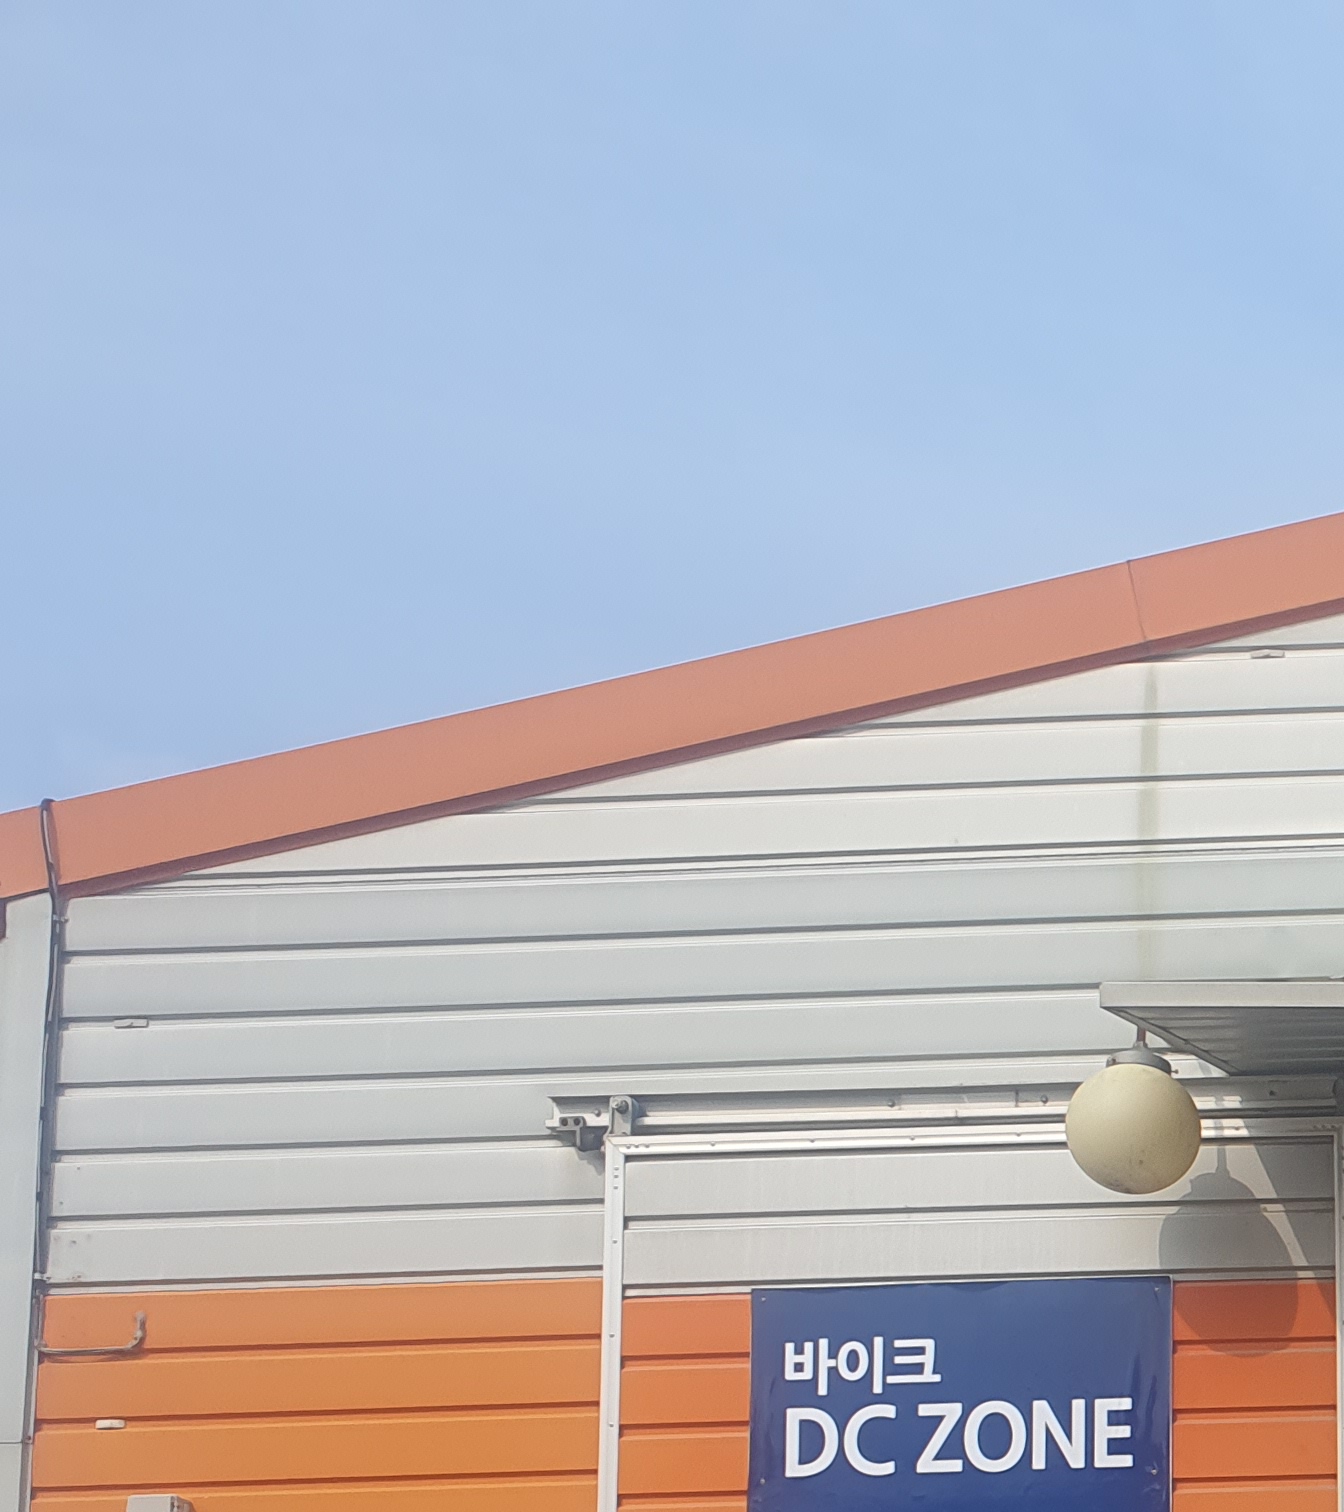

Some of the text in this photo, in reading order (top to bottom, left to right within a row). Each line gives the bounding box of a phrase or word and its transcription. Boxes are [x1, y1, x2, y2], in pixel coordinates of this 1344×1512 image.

[784, 1336, 942, 1396] 바이크
[784, 1396, 1134, 1478] DC ZONE
